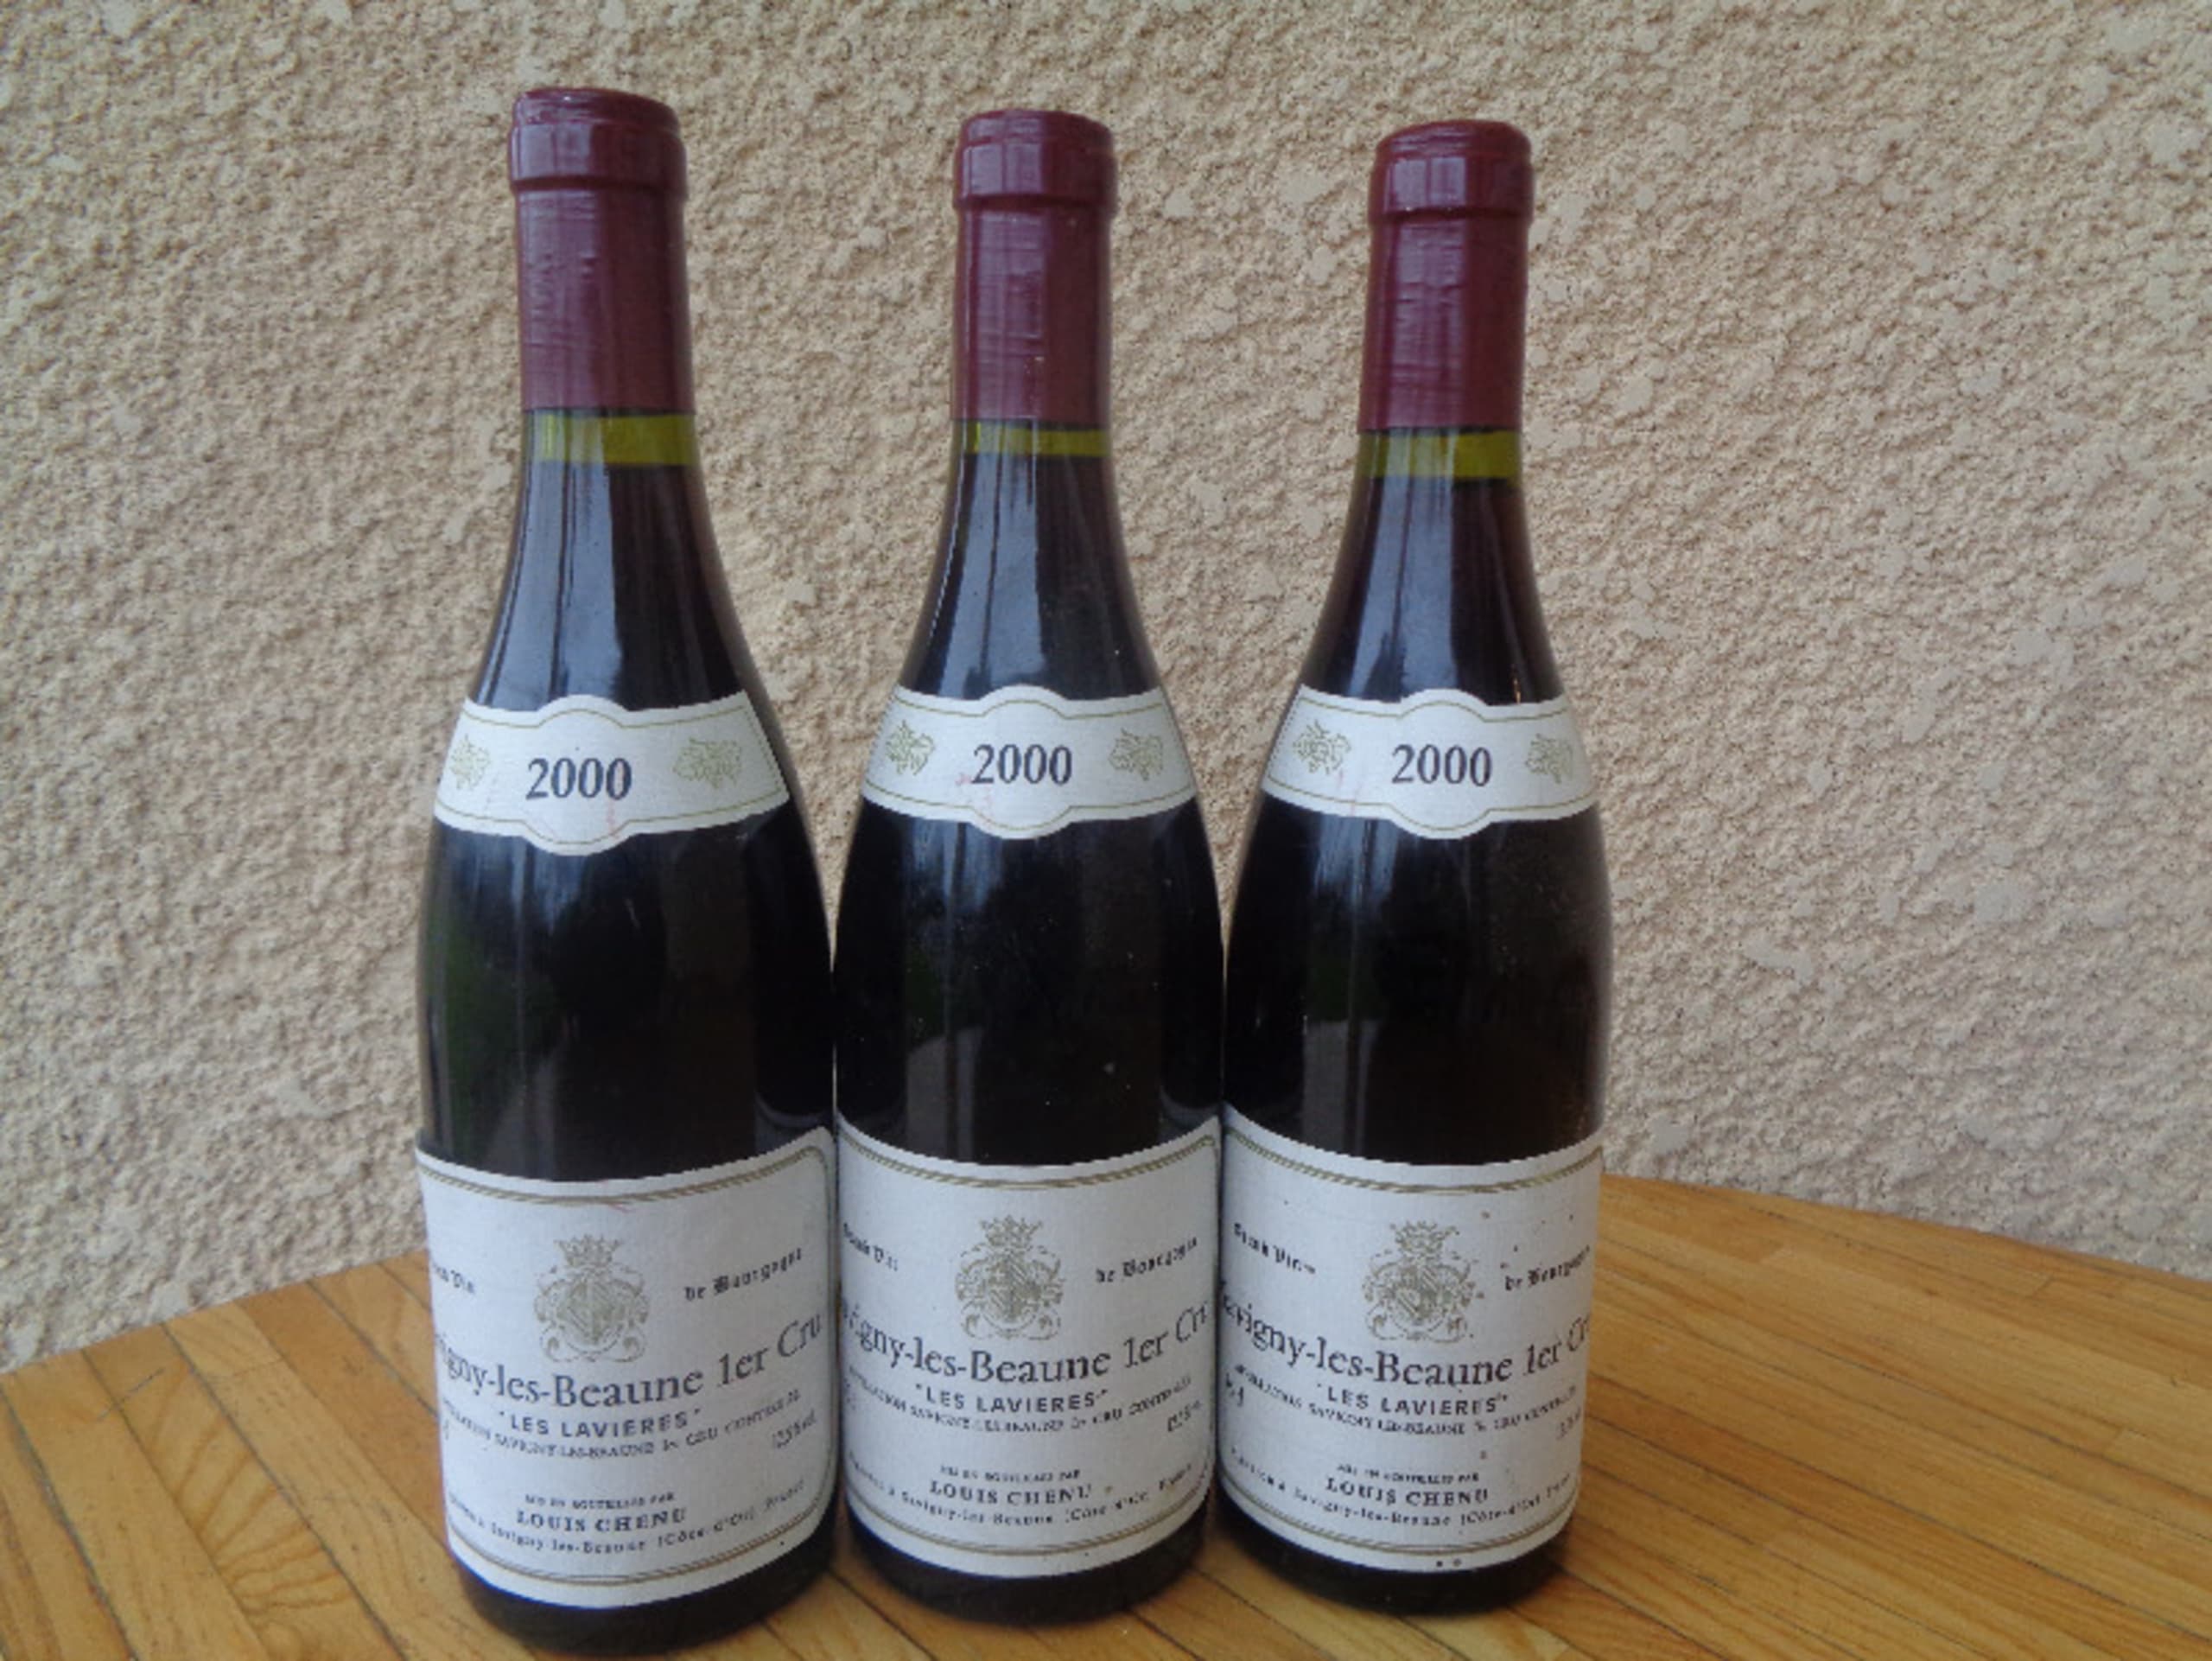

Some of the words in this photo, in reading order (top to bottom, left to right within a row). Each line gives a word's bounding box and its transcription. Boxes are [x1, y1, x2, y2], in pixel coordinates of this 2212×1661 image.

[525, 757, 632, 801] 2000
[972, 743, 1073, 786] 2000
[1391, 743, 1493, 787] 2000
[715, 1352, 769, 1388] 1er
[777, 1314, 823, 1359] Cru
[1122, 1331, 1169, 1368] 1er
[929, 1479, 999, 1505] LOUIS
[1006, 1483, 1092, 1506] CHENU
[1325, 1476, 1397, 1506] LOUIS
[1405, 1487, 1489, 1507] CHENU
[516, 1508, 587, 1532] LOUIS
[594, 1506, 687, 1532] CHENU
